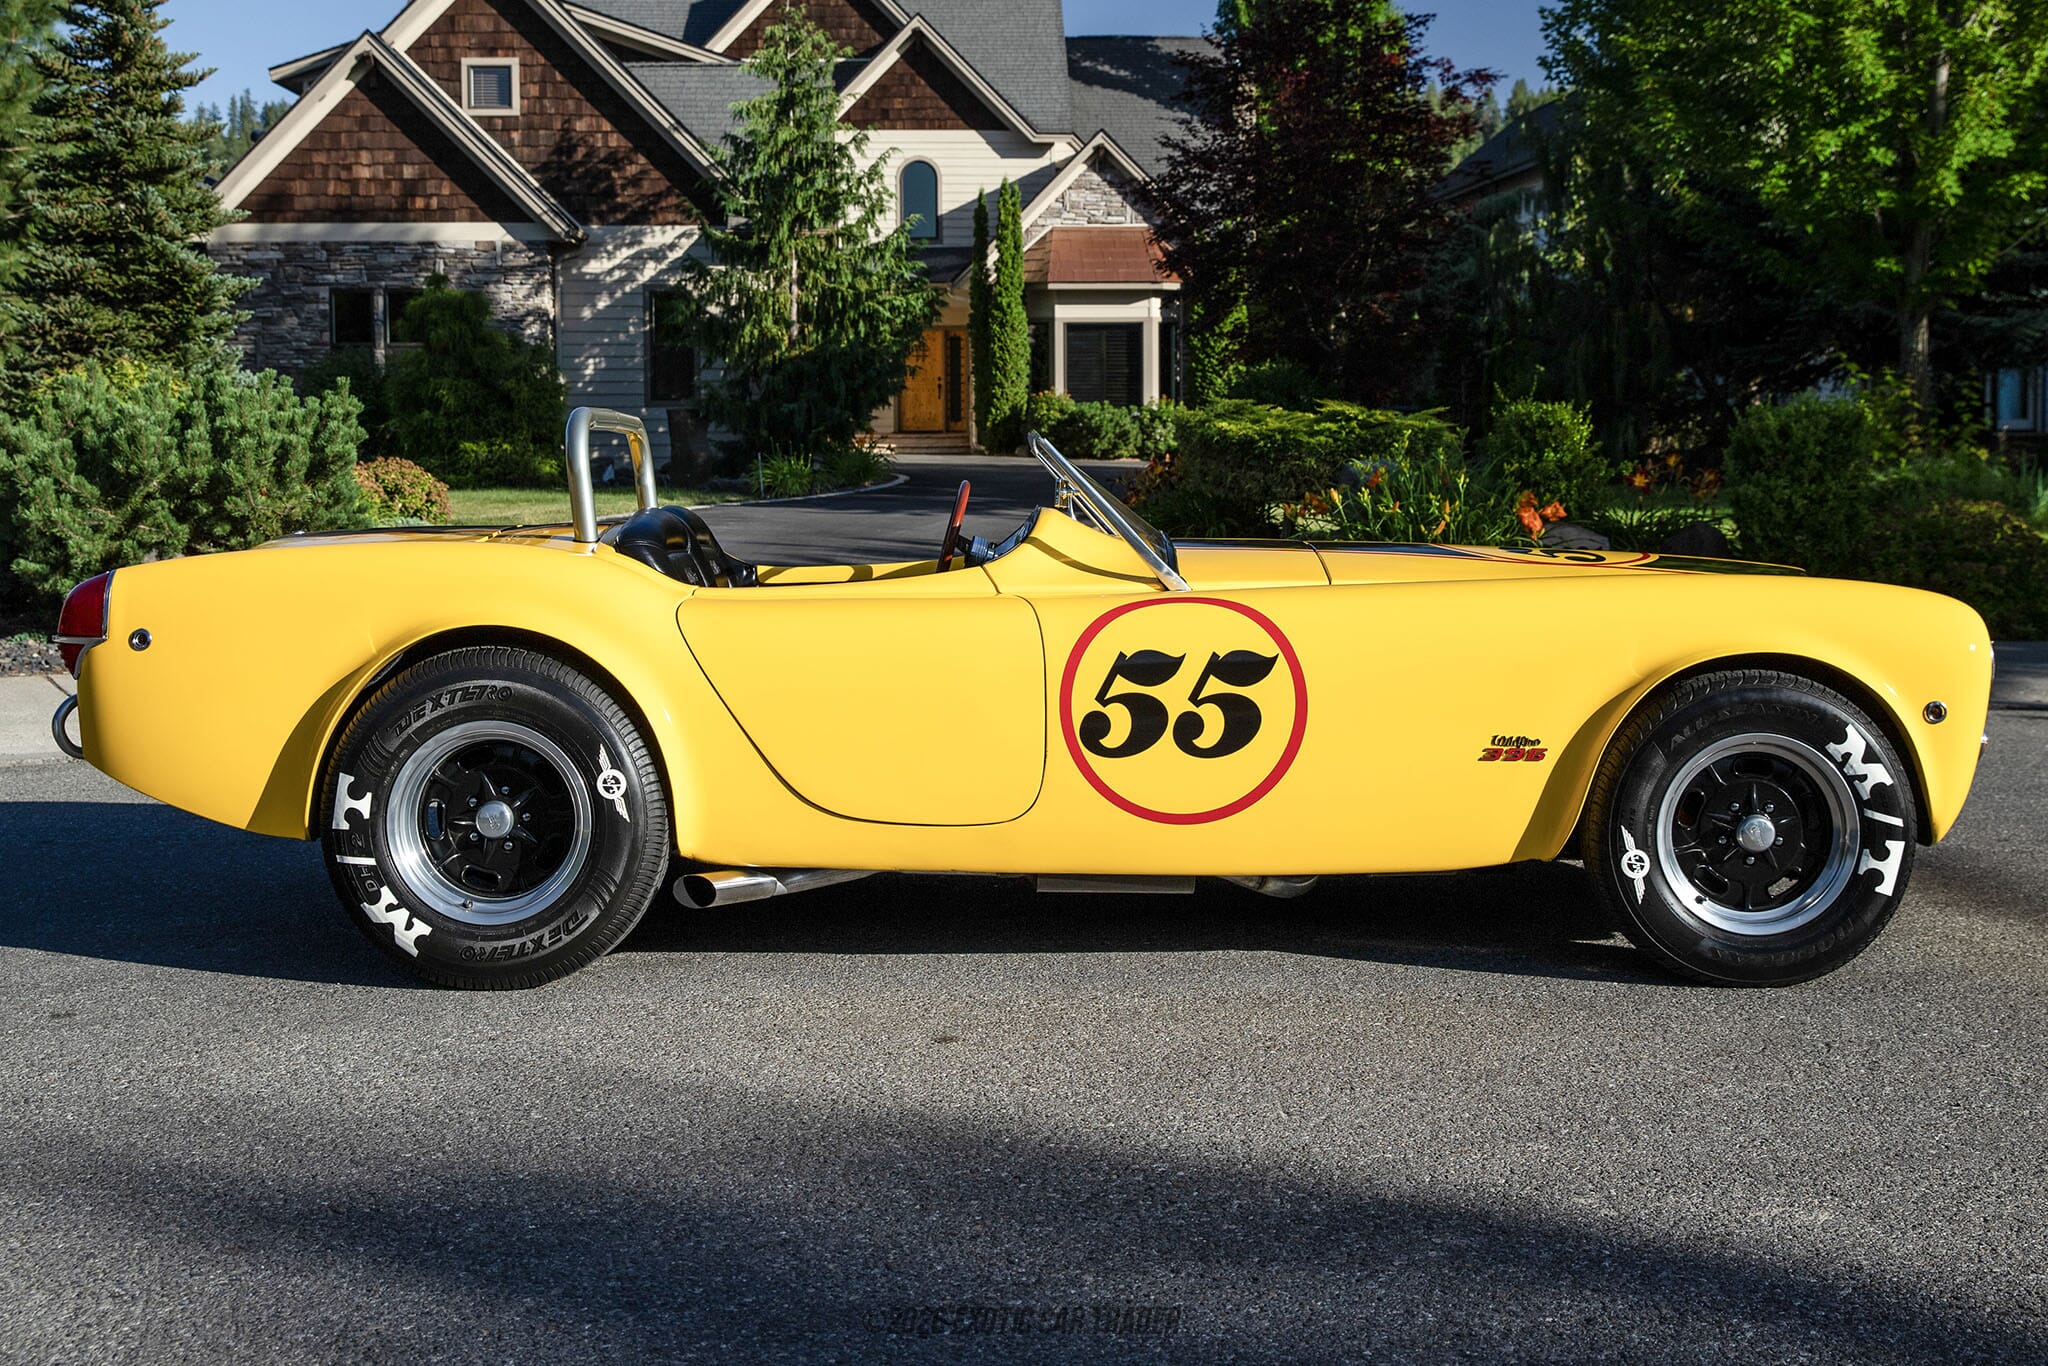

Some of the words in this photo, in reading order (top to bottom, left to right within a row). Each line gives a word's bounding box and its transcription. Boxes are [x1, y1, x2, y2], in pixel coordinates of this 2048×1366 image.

[388, 684, 513, 737] DEXTERO
[1079, 649, 1279, 759] 55
[1477, 748, 1548, 762] 396
[1825, 723, 1906, 897] M/T
[331, 772, 433, 958] M/T
[459, 905, 589, 962] DEXTERO
